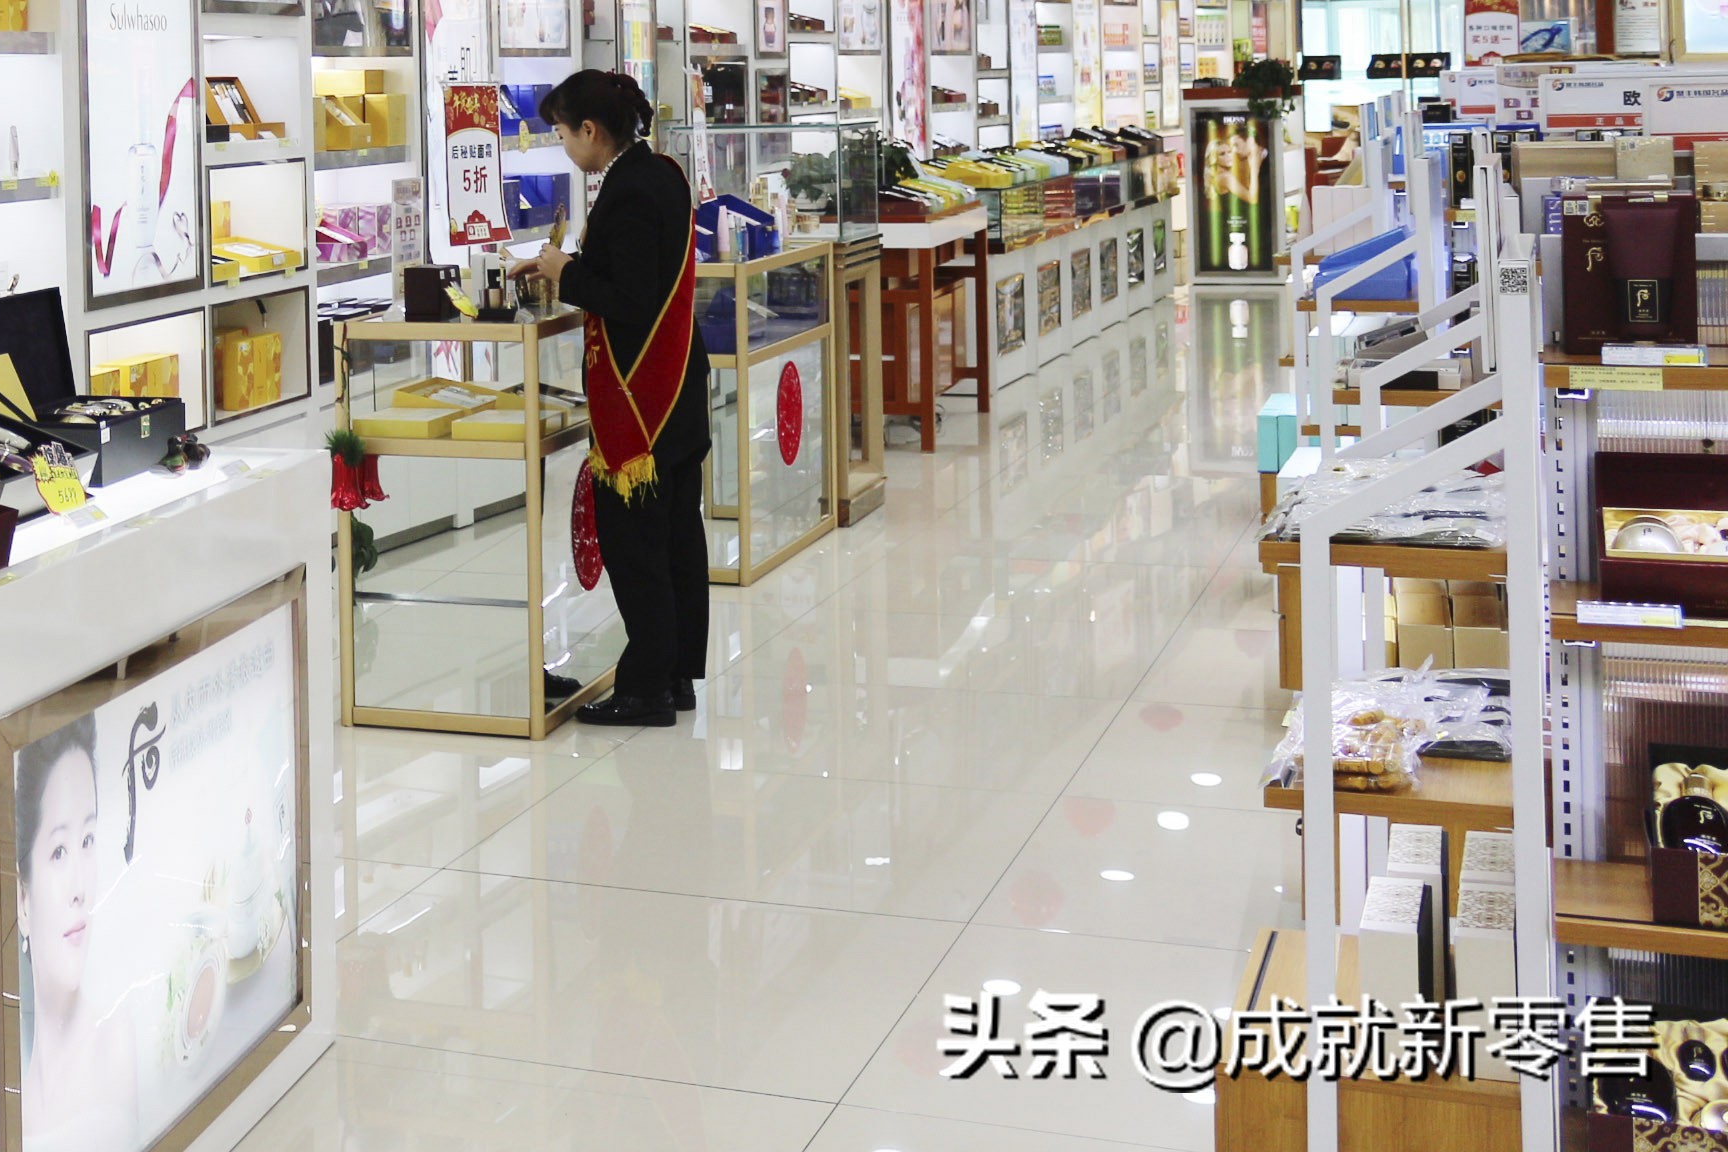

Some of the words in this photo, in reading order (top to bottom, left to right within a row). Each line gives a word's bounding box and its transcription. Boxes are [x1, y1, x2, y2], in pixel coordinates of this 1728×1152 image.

[109, 2, 168, 32] Sulwhasoo
[1623, 90, 1641, 106] 欧
[462, 166, 488, 194] 5折
